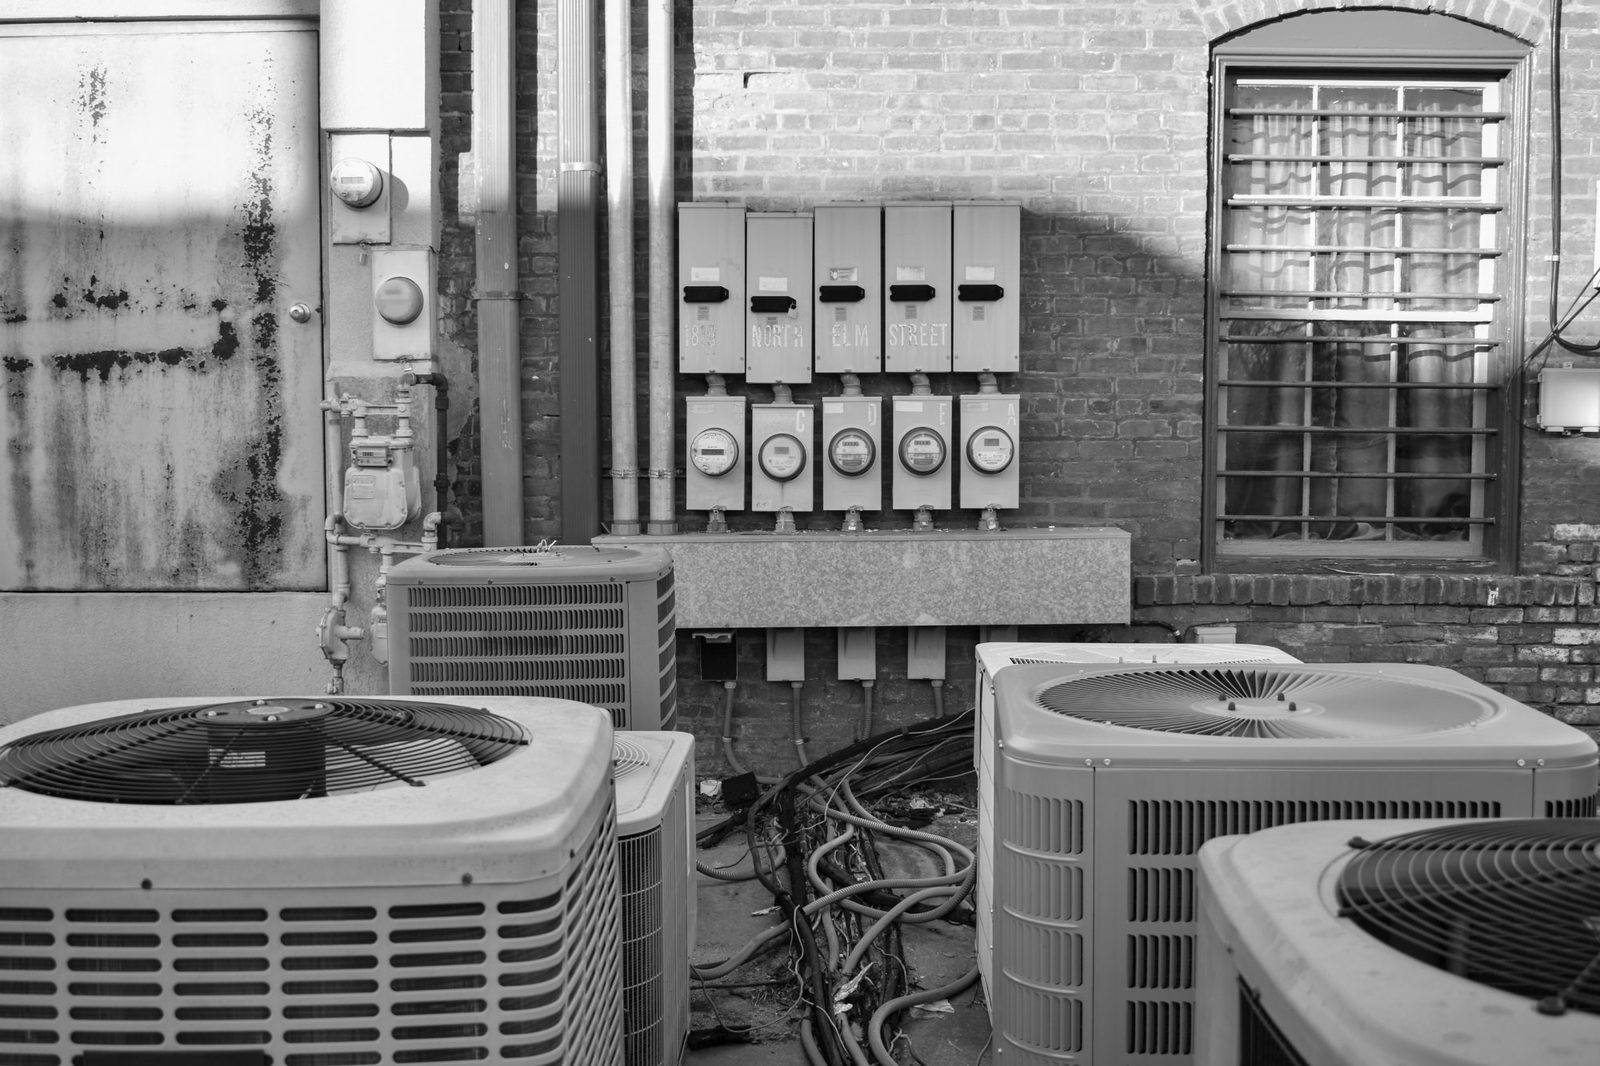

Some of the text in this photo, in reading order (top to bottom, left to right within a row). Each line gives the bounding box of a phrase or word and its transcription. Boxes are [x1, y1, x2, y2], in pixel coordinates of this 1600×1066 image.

[684, 323, 948, 348] 18 NORTH ELM STREET
[795, 409, 806, 433] C
[939, 403, 947, 426] E
[1007, 403, 1017, 426] A
